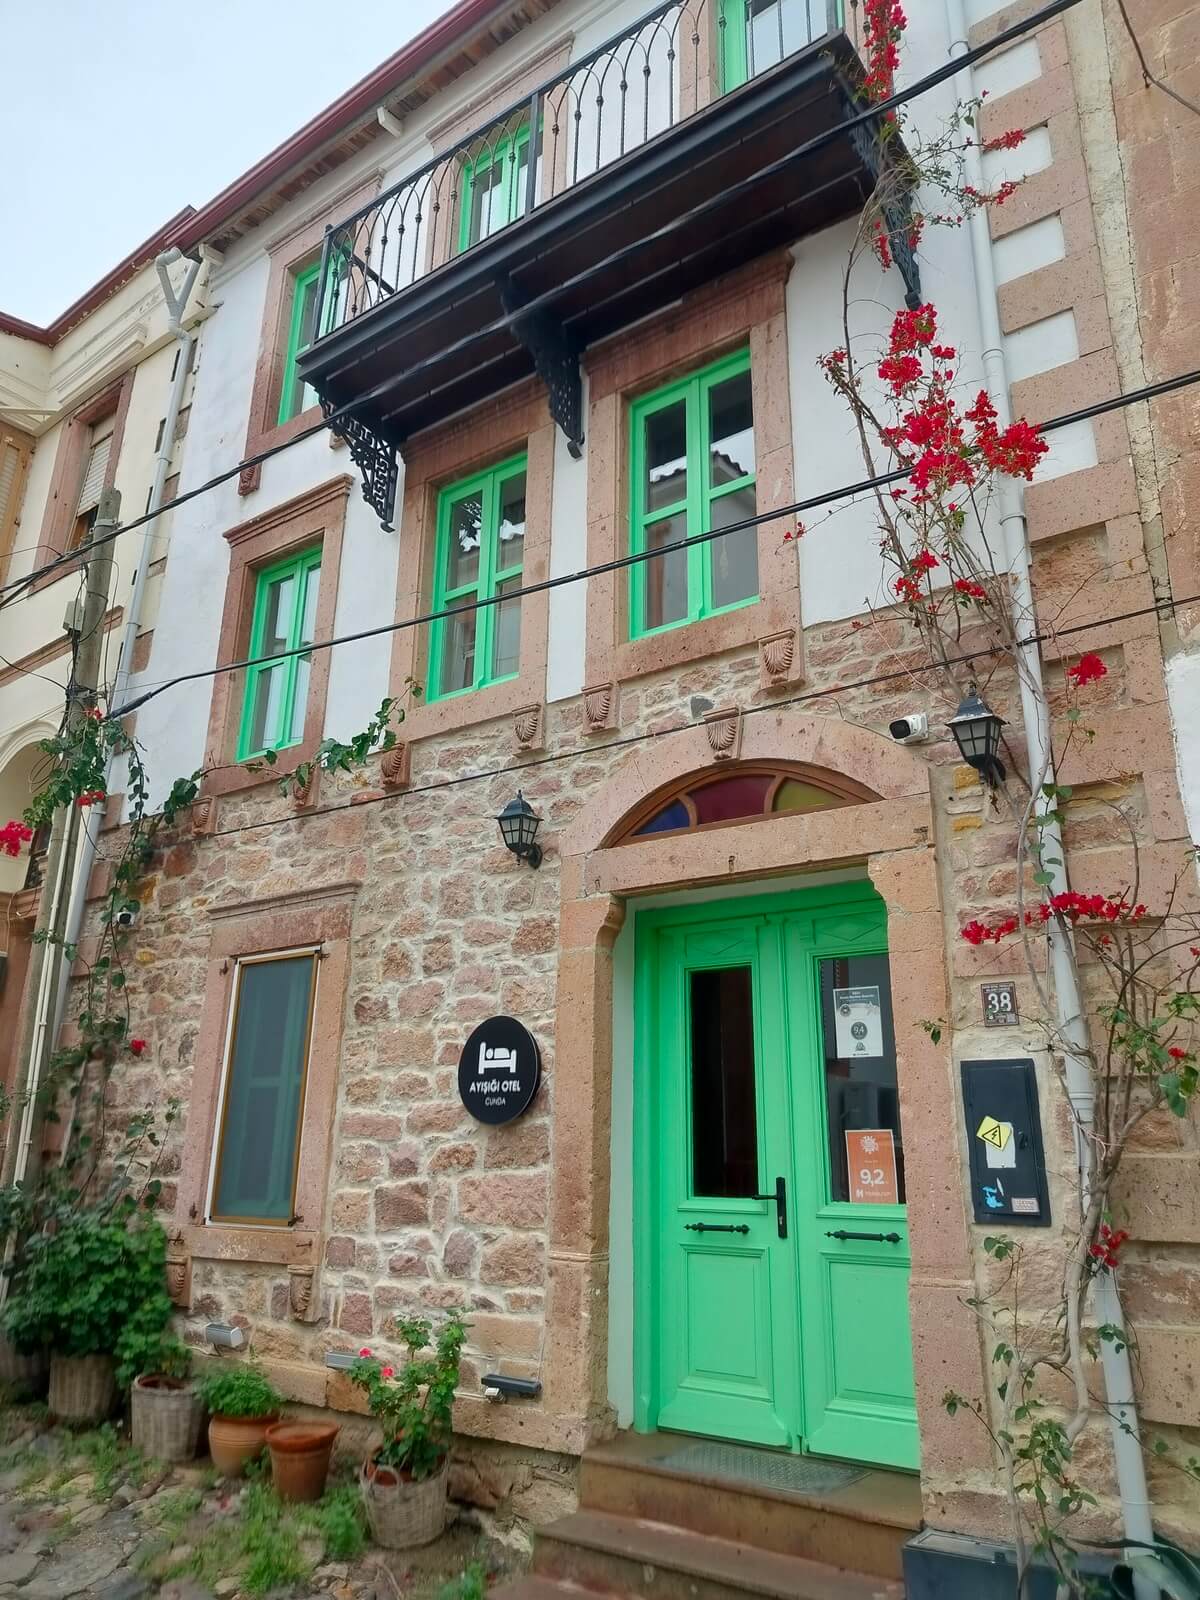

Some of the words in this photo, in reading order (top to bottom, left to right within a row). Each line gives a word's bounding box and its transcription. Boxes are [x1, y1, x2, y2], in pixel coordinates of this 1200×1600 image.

[988, 992, 1012, 1013] 38
[469, 1079, 500, 1095] AYIŞIĞI
[501, 1080, 521, 1093] OTEL
